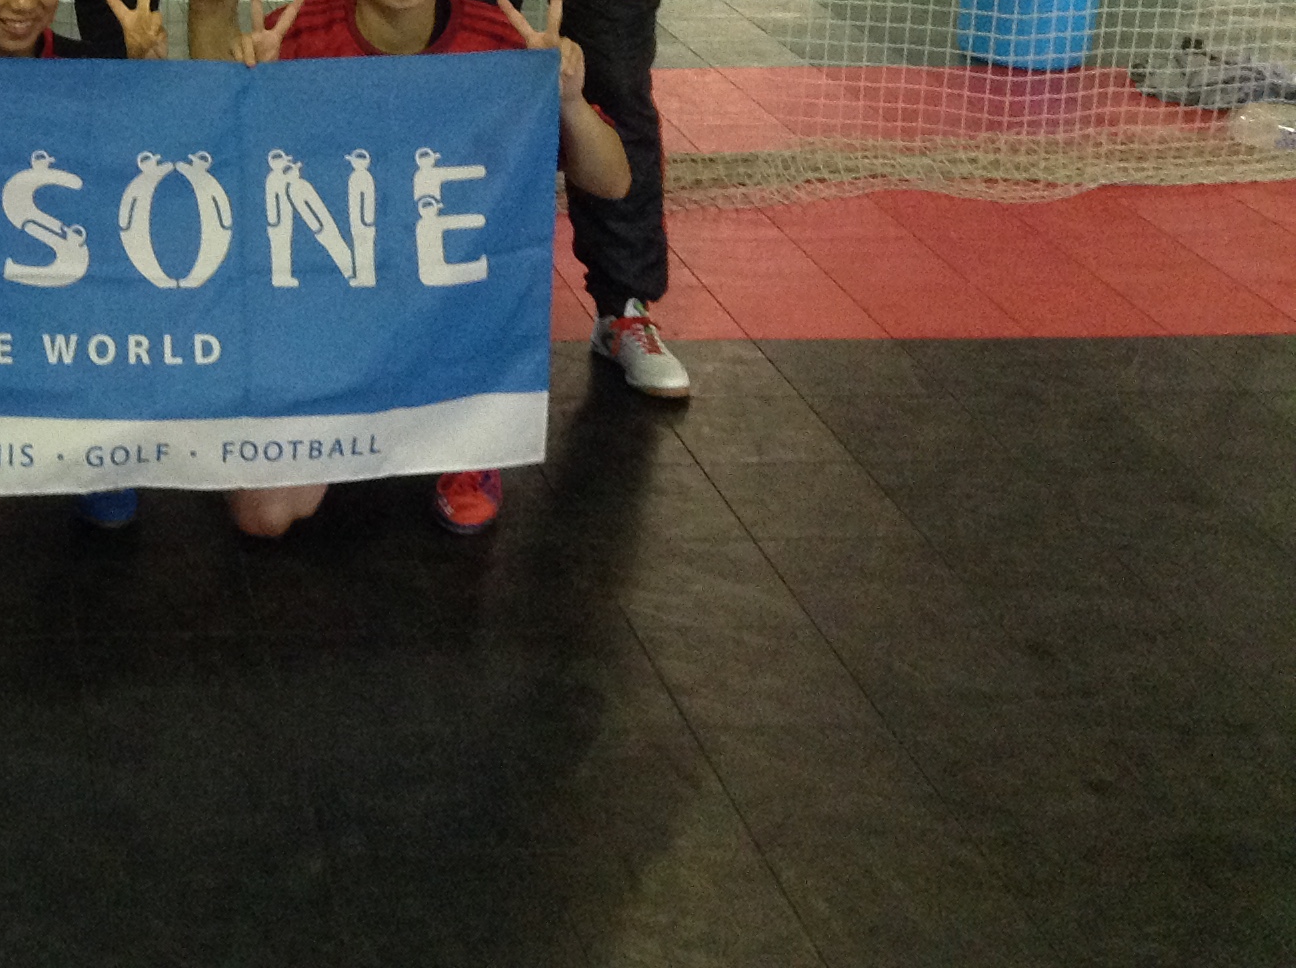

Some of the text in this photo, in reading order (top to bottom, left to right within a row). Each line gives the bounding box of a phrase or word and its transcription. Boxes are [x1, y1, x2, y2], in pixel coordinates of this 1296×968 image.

[42, 333, 222, 366] WORLD
[85, 443, 172, 468] GOLF
[221, 434, 382, 464] FOOTBALL
